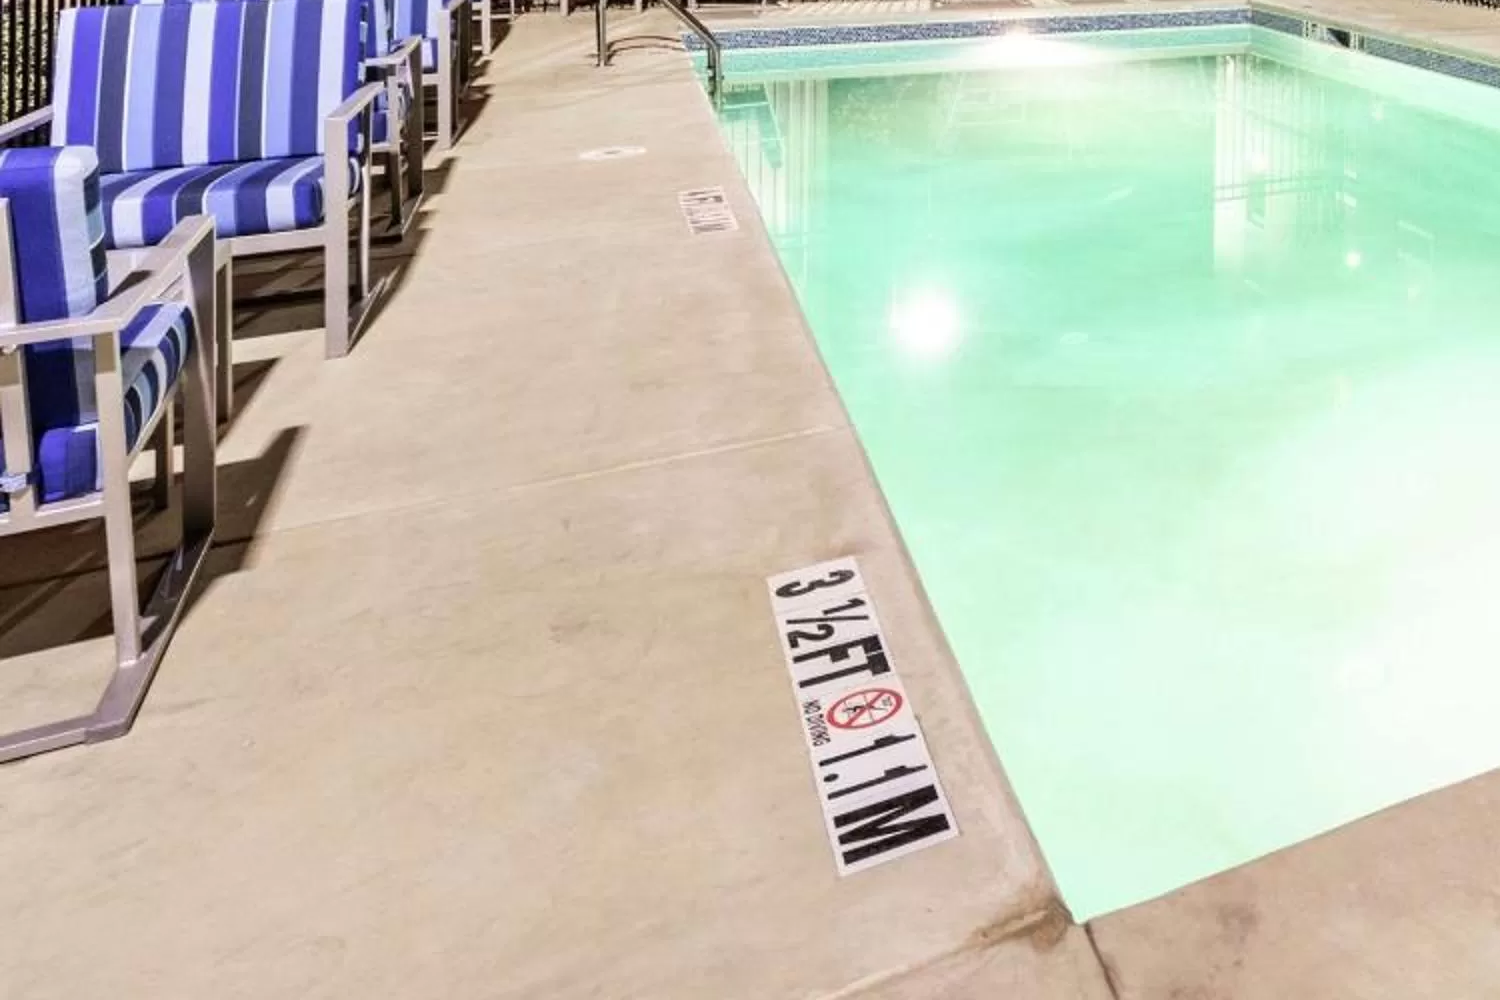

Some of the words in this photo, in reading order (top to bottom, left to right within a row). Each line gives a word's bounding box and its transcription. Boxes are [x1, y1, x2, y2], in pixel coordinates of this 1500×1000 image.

[775, 569, 855, 598] 3
[792, 634, 891, 689] FT
[803, 700, 821, 714] NO
